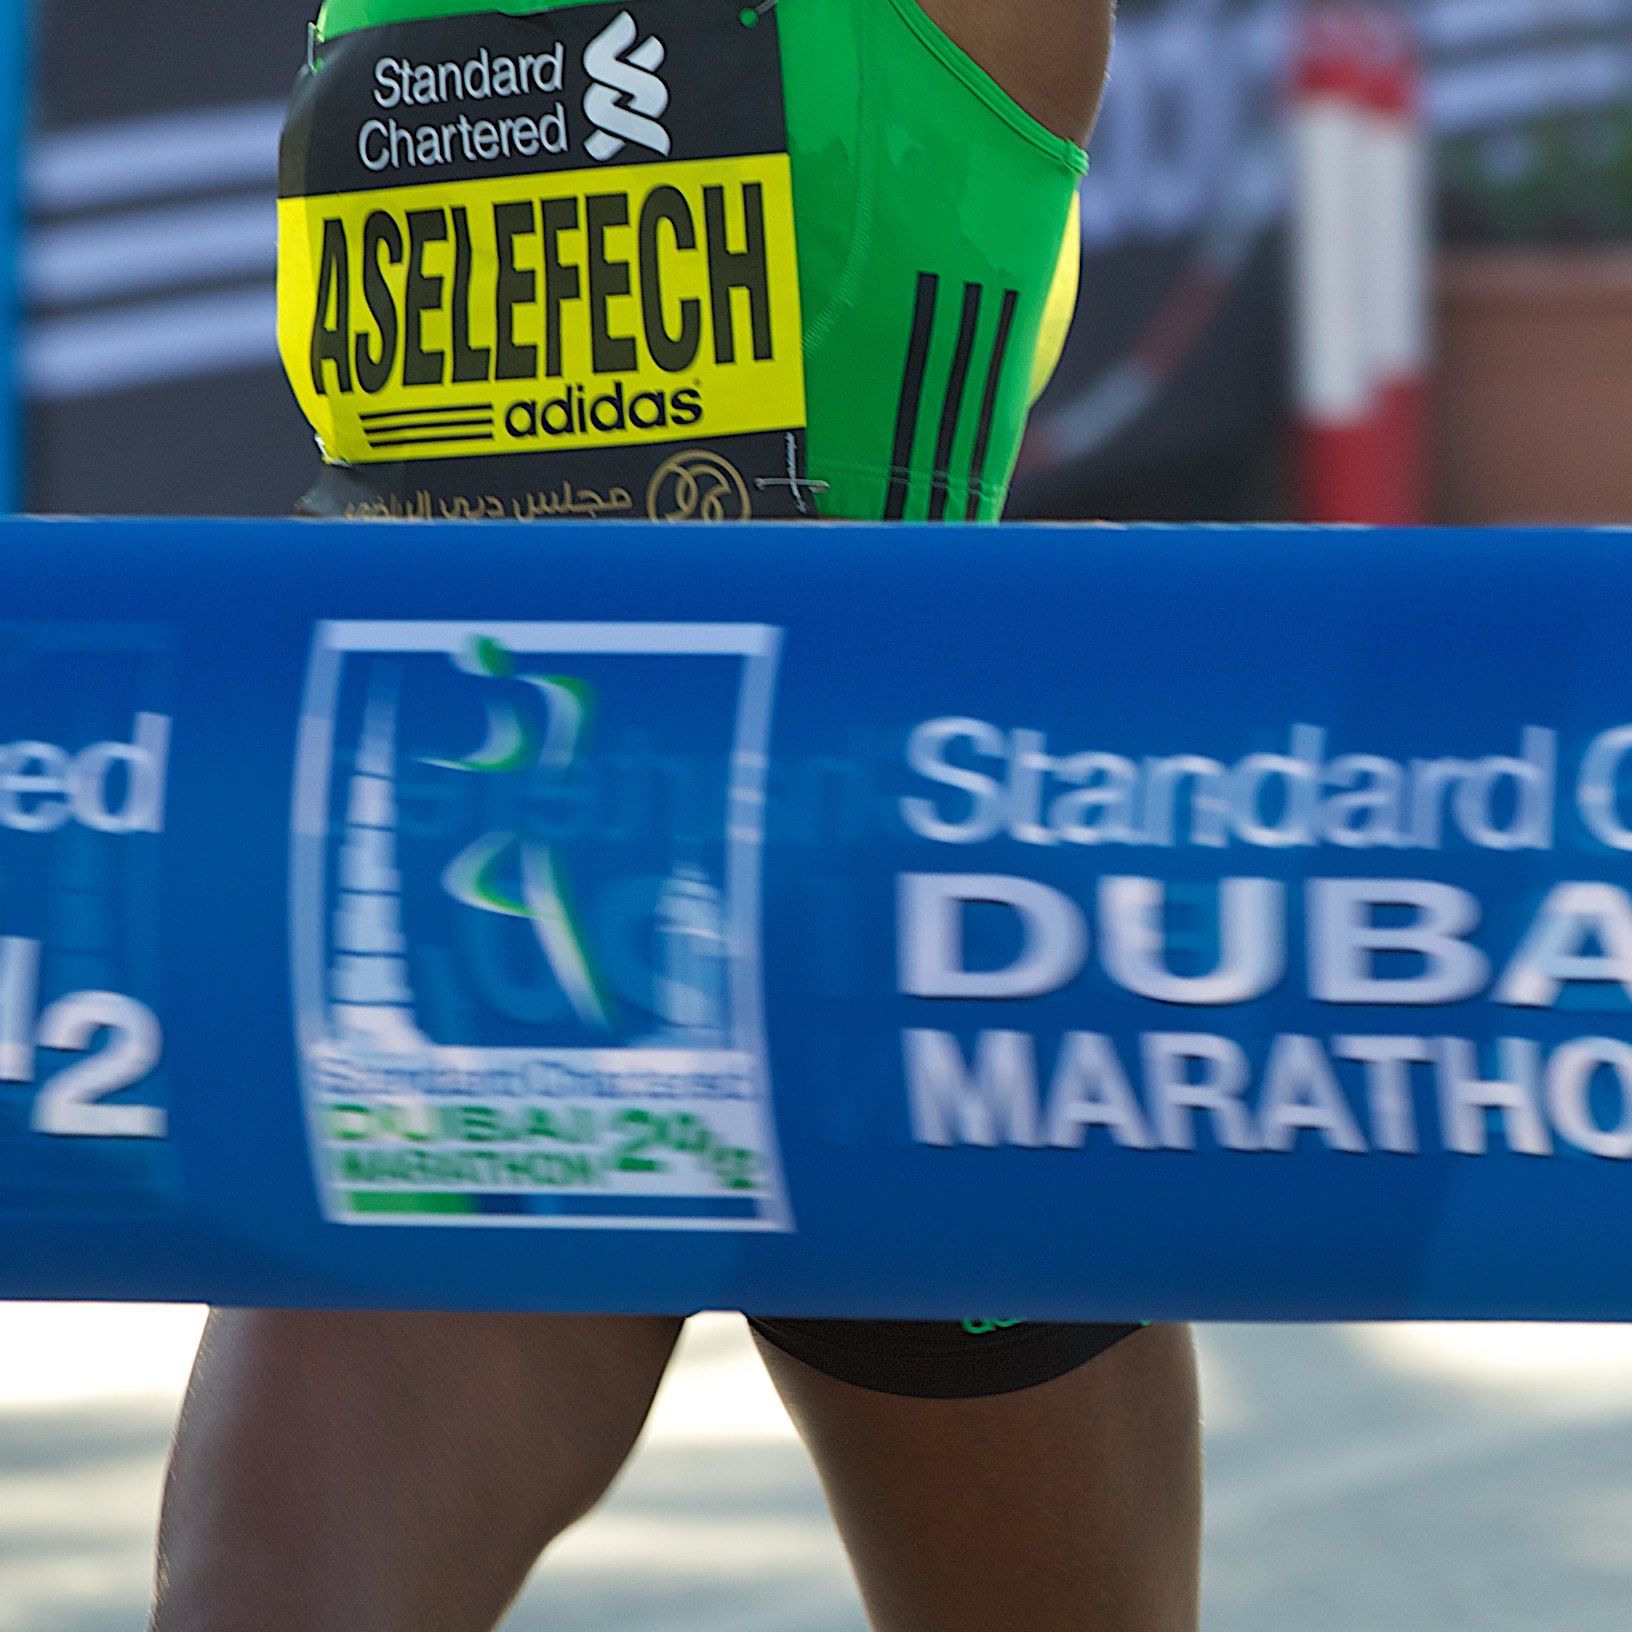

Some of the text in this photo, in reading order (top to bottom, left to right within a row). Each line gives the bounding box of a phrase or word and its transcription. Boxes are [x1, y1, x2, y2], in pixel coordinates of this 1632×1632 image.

[373, 41, 565, 109] Standard
[357, 101, 569, 172] Chartered
[310, 181, 775, 396] ASELEFECH
[504, 380, 703, 439] adidas
[898, 715, 1558, 852] Standard
[321, 1102, 599, 1144] DUBAI
